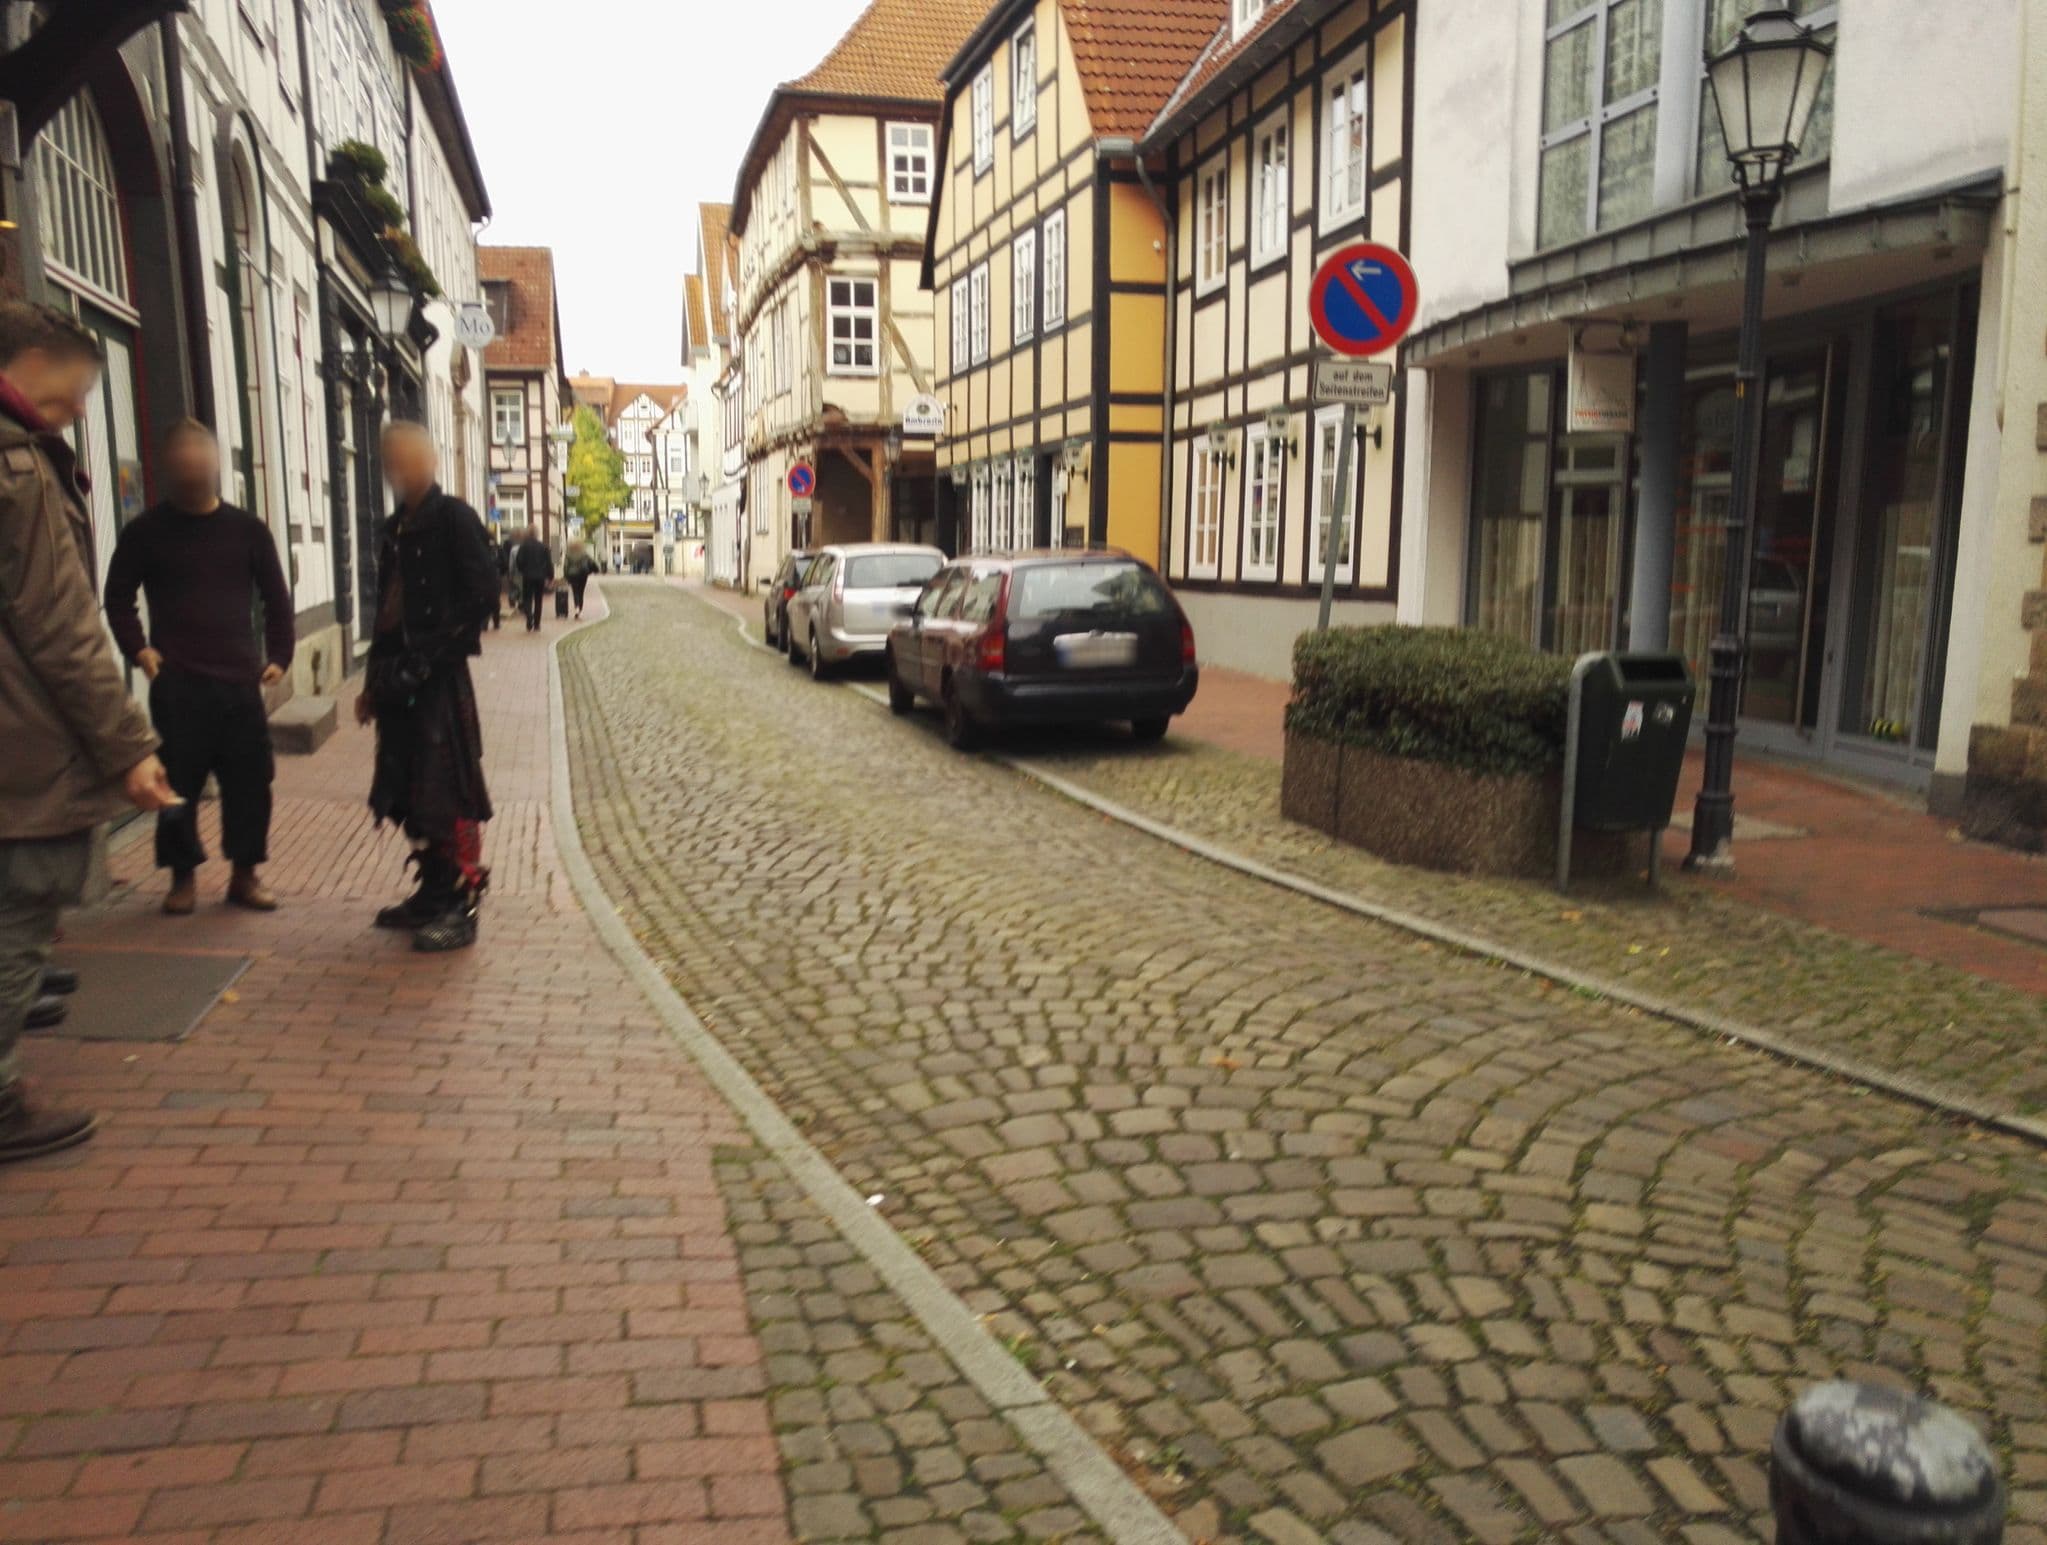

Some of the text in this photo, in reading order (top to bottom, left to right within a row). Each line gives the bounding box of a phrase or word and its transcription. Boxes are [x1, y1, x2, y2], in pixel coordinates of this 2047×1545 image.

[460, 317, 490, 335] Mo
[1333, 370, 1373, 381] auf dem
[1320, 382, 1384, 398] Seitenstreifen
